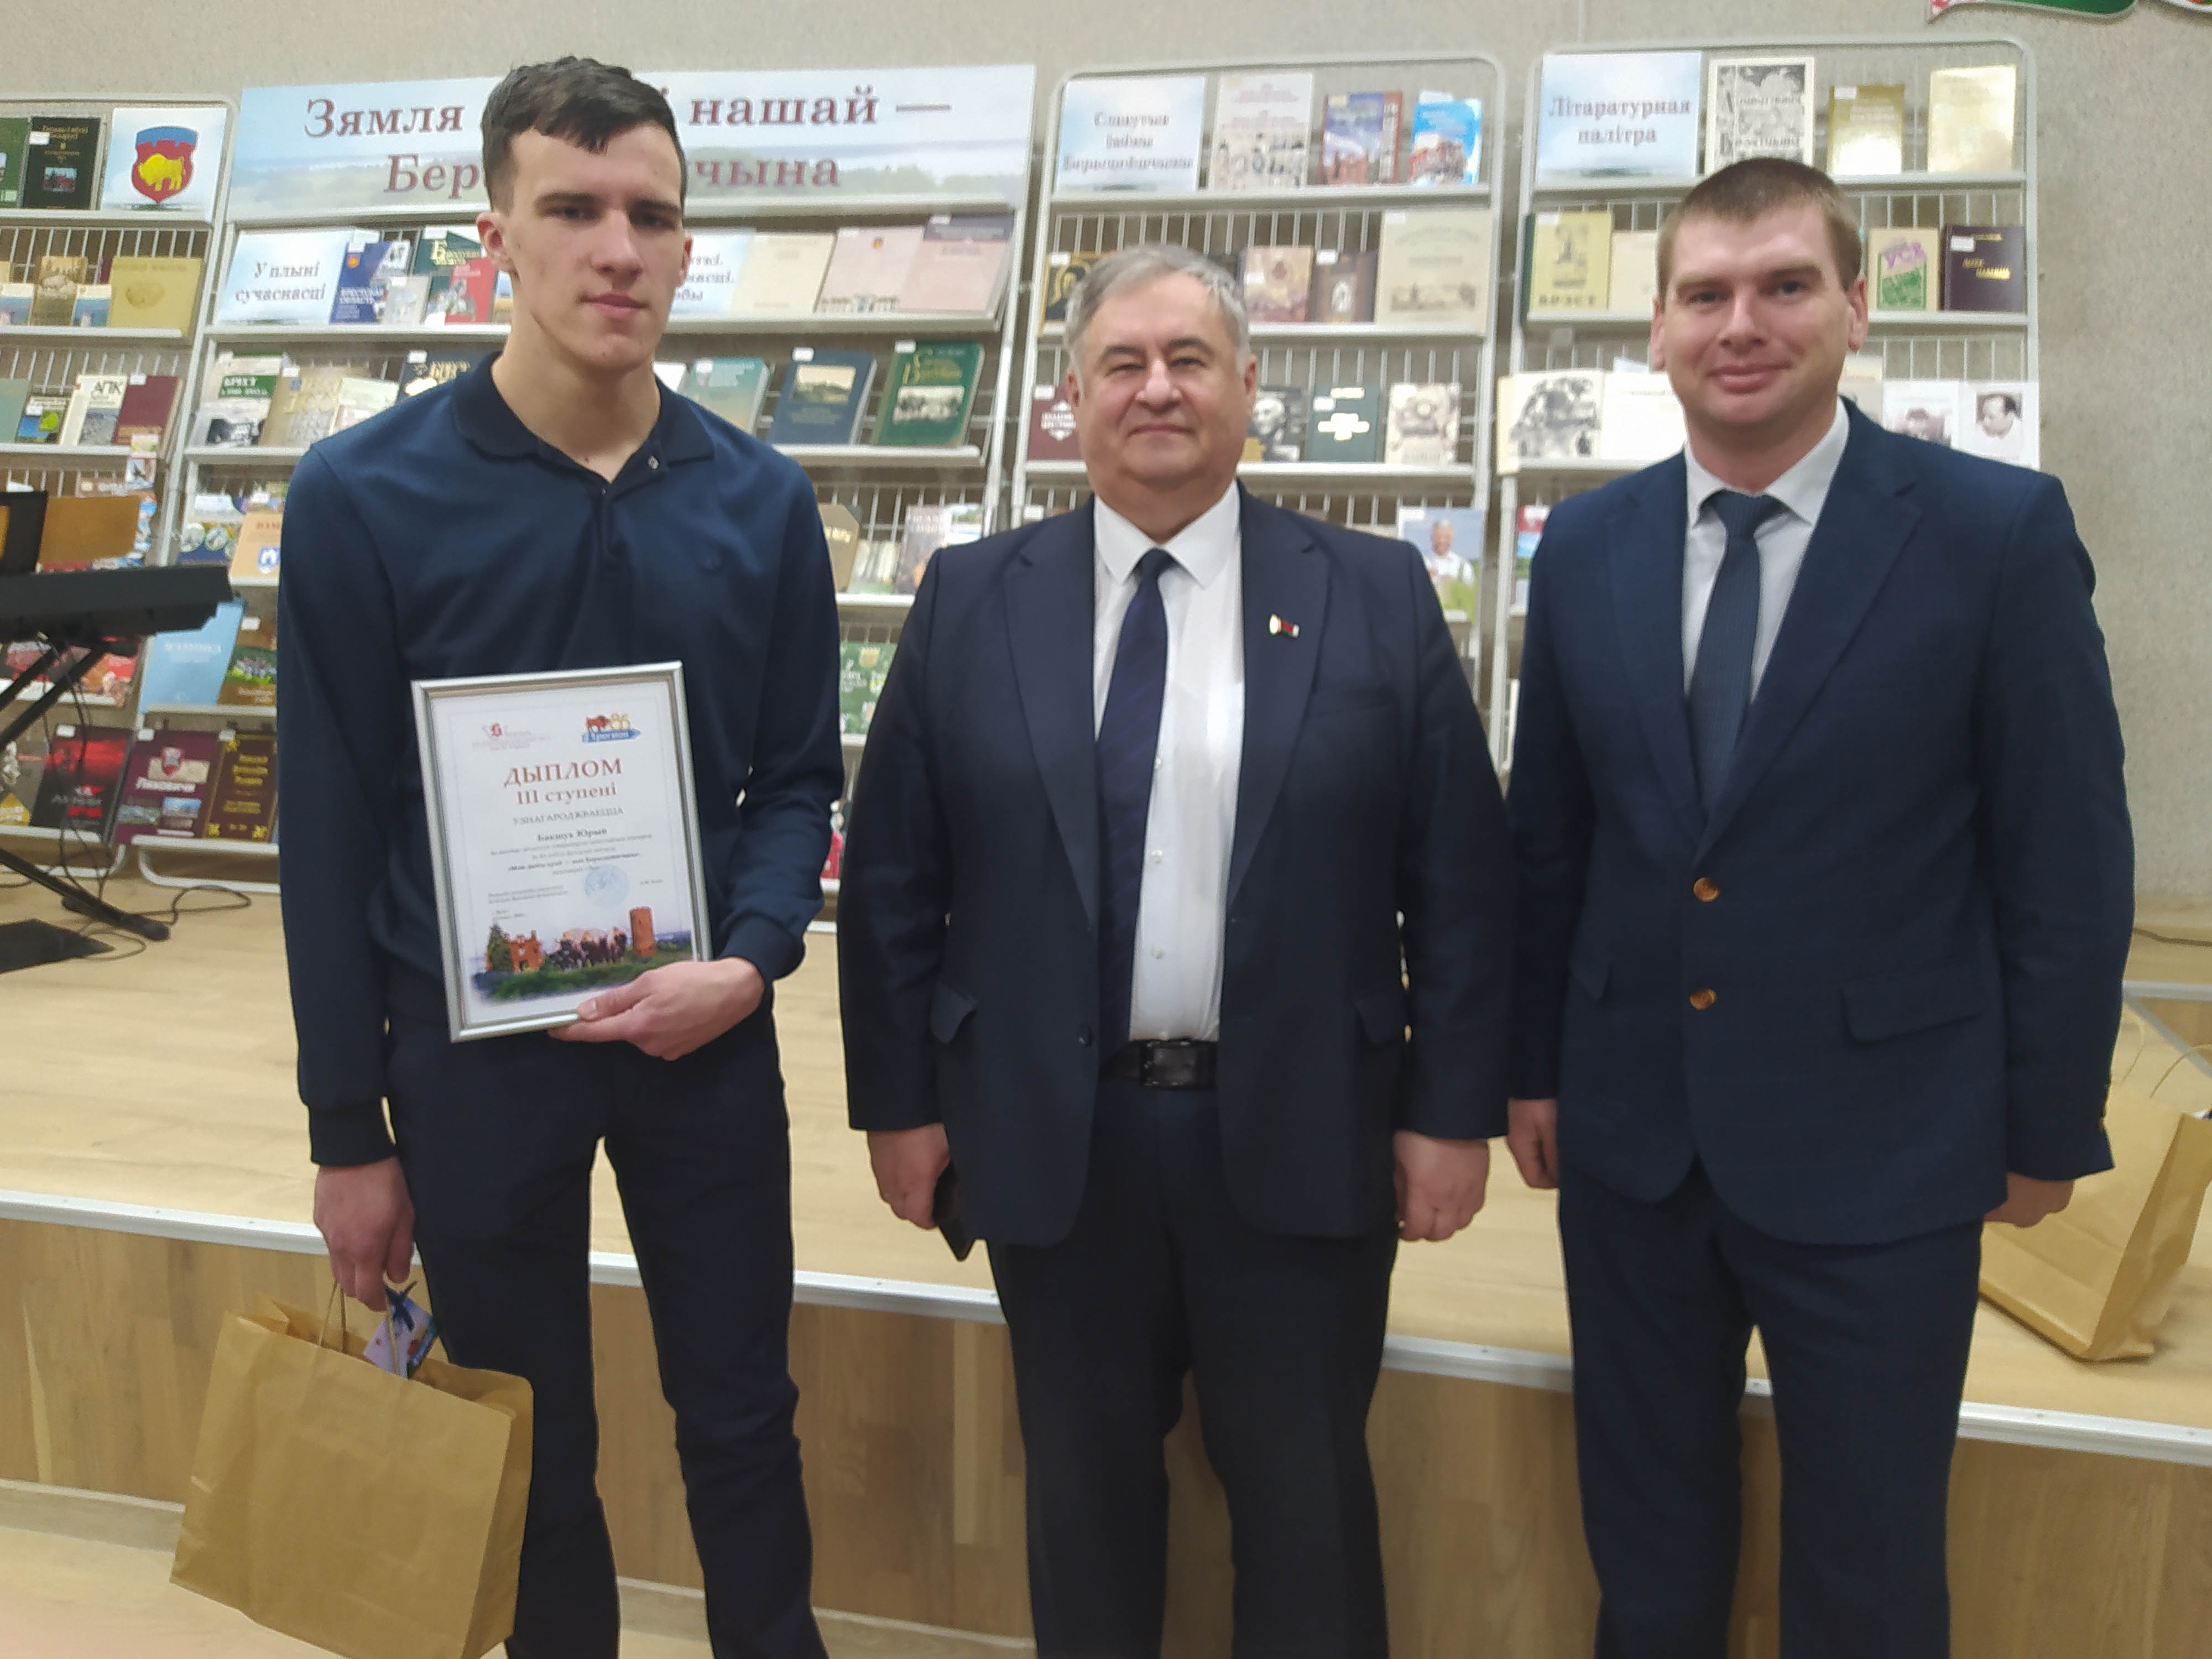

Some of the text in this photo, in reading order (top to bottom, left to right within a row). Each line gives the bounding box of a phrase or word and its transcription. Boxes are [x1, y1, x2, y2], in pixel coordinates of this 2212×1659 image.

[305, 98, 465, 138] Зямля
[689, 84, 879, 126] нашай
[254, 261, 320, 278] У плыні
[236, 283, 326, 304] сучаснасці
[503, 758, 622, 788] ДЫПЛОМ
[545, 781, 617, 805] ступені
